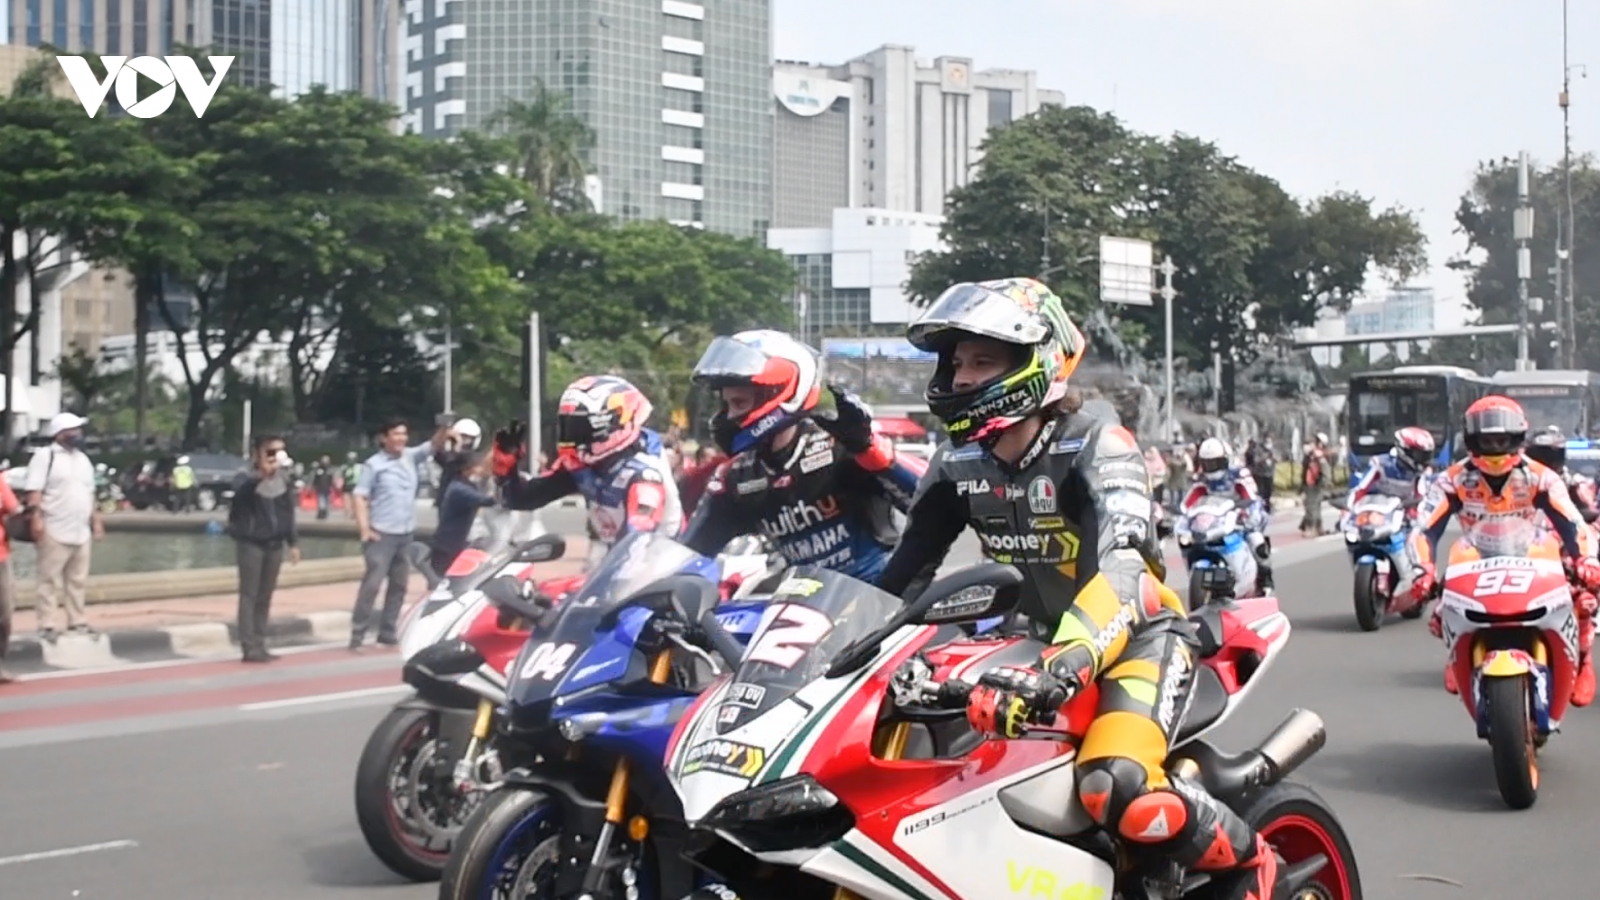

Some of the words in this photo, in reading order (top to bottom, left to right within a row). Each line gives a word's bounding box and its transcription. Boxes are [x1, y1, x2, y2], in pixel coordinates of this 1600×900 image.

[956, 479, 990, 496] FILA
[1472, 569, 1535, 598] 93
[520, 641, 577, 681] 04
[904, 811, 946, 836] 1199
